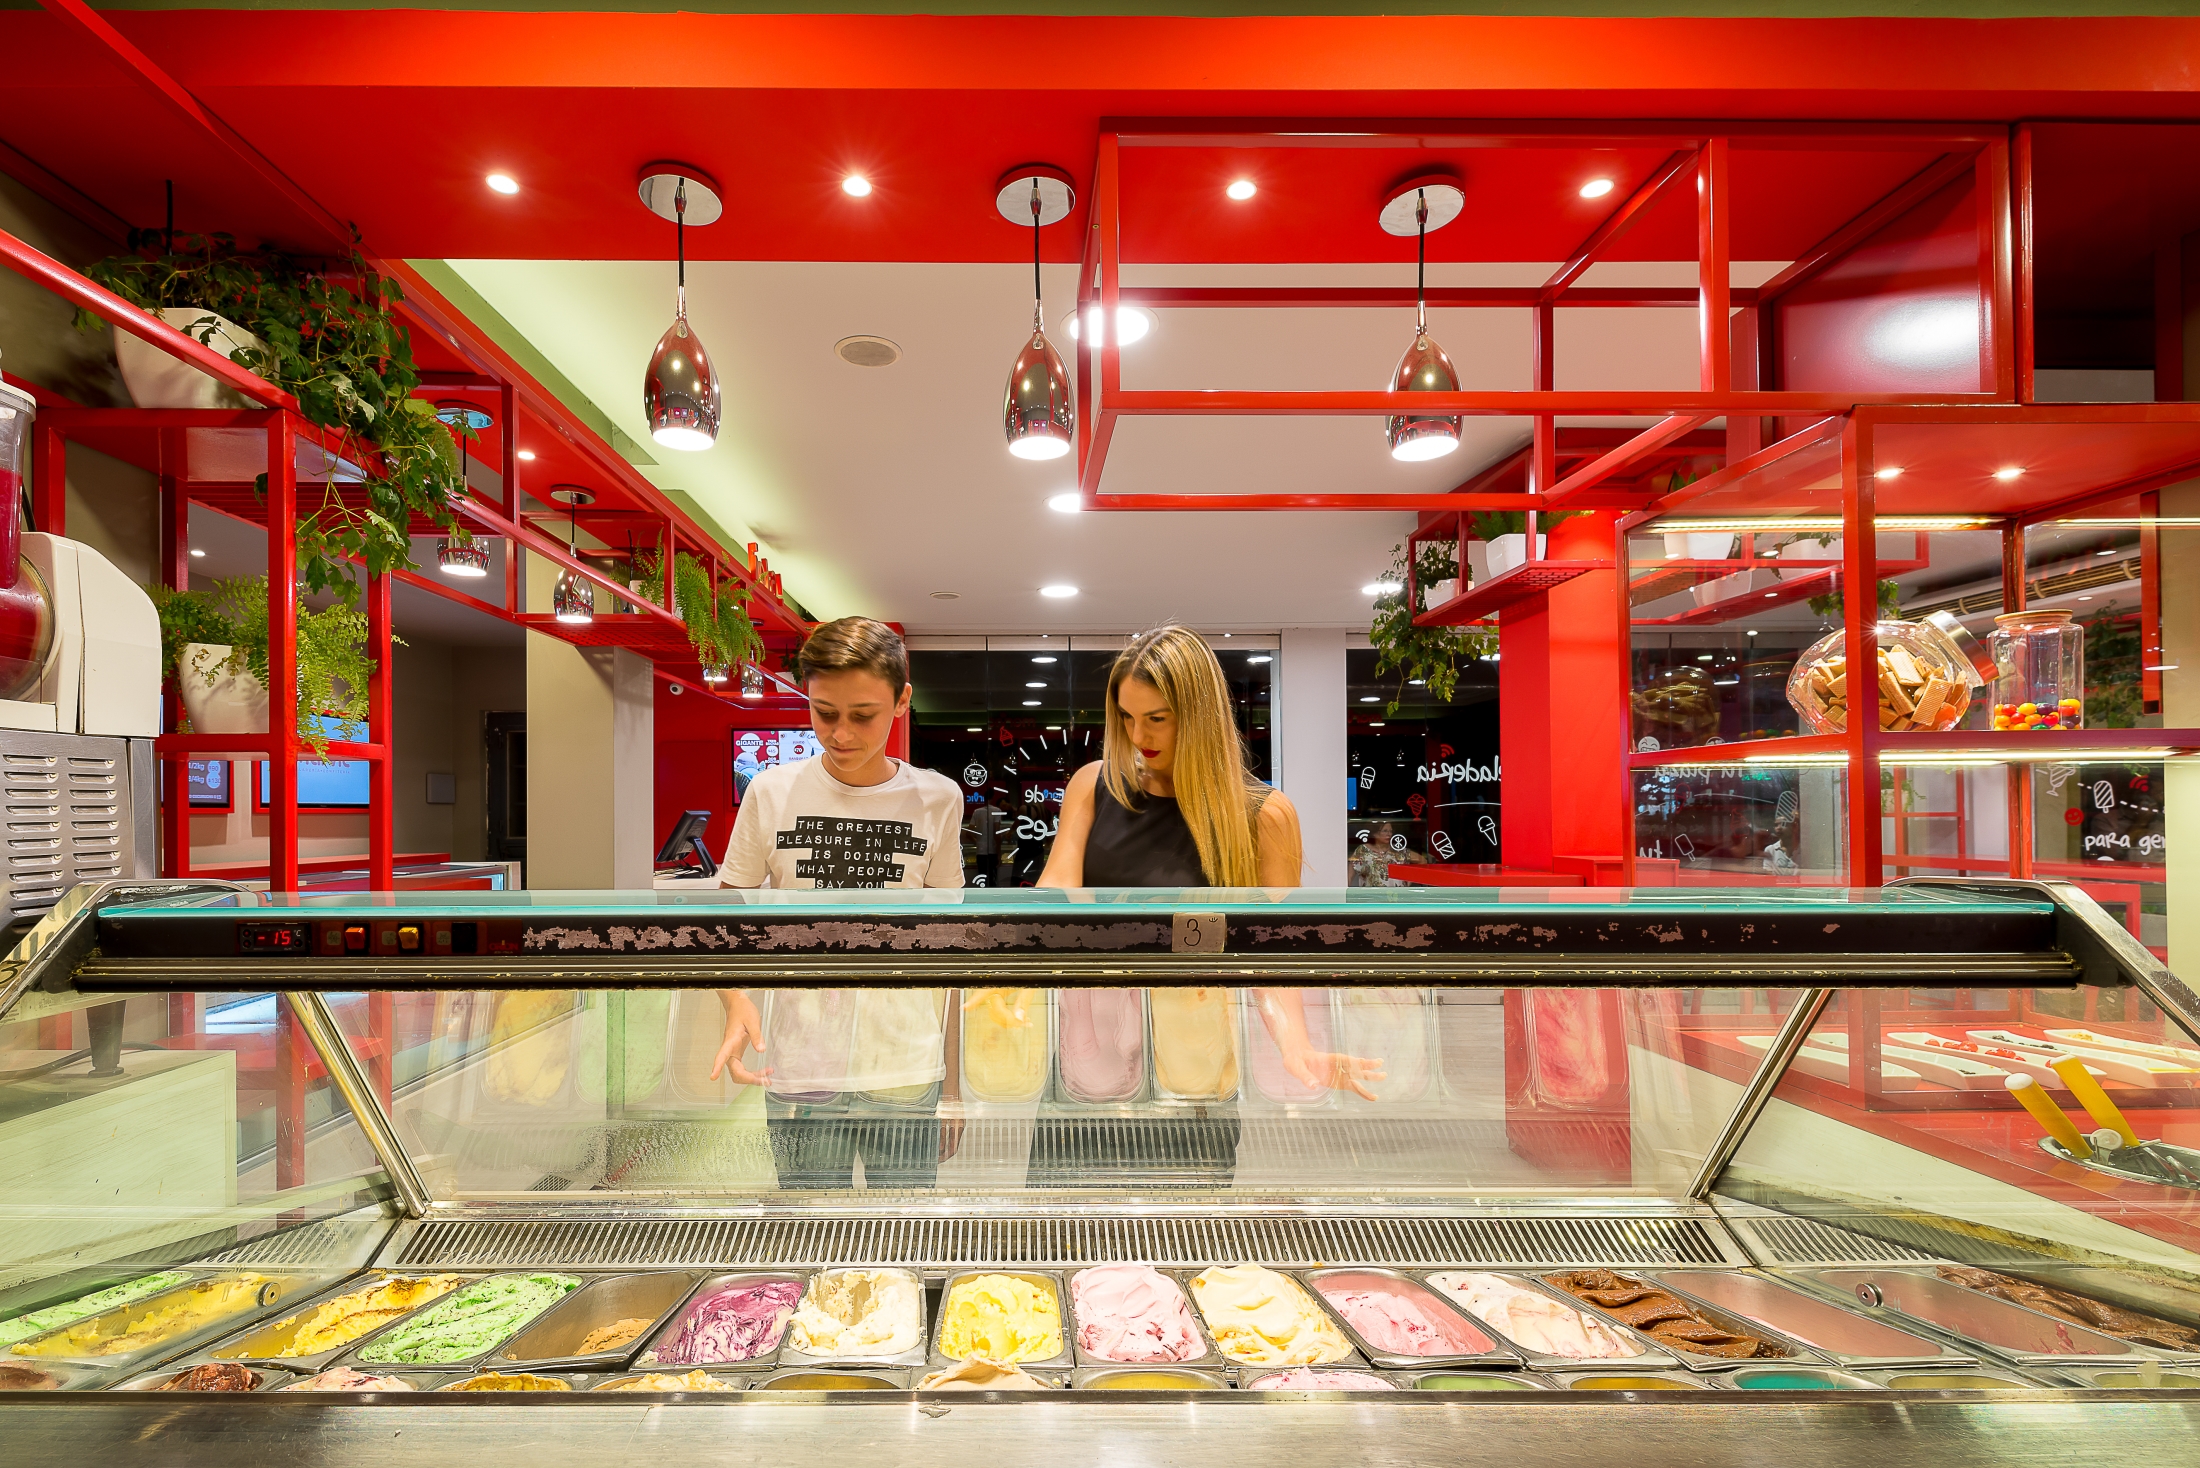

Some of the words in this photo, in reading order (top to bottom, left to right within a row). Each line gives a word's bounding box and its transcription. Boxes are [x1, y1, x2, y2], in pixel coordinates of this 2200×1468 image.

[797, 820, 824, 830] THE
[836, 822, 911, 836] GREATEST
[777, 834, 852, 846] PLEASURE
[865, 838, 882, 848] IN
[893, 839, 926, 852] LIFE
[814, 850, 832, 859] IS
[843, 851, 891, 862] DOING
[797, 864, 836, 874] WHAT
[847, 866, 903, 878] PEOPLE
[816, 879, 845, 889] SAY
[856, 881, 884, 889] YOU
[1183, 918, 1202, 947] 3
